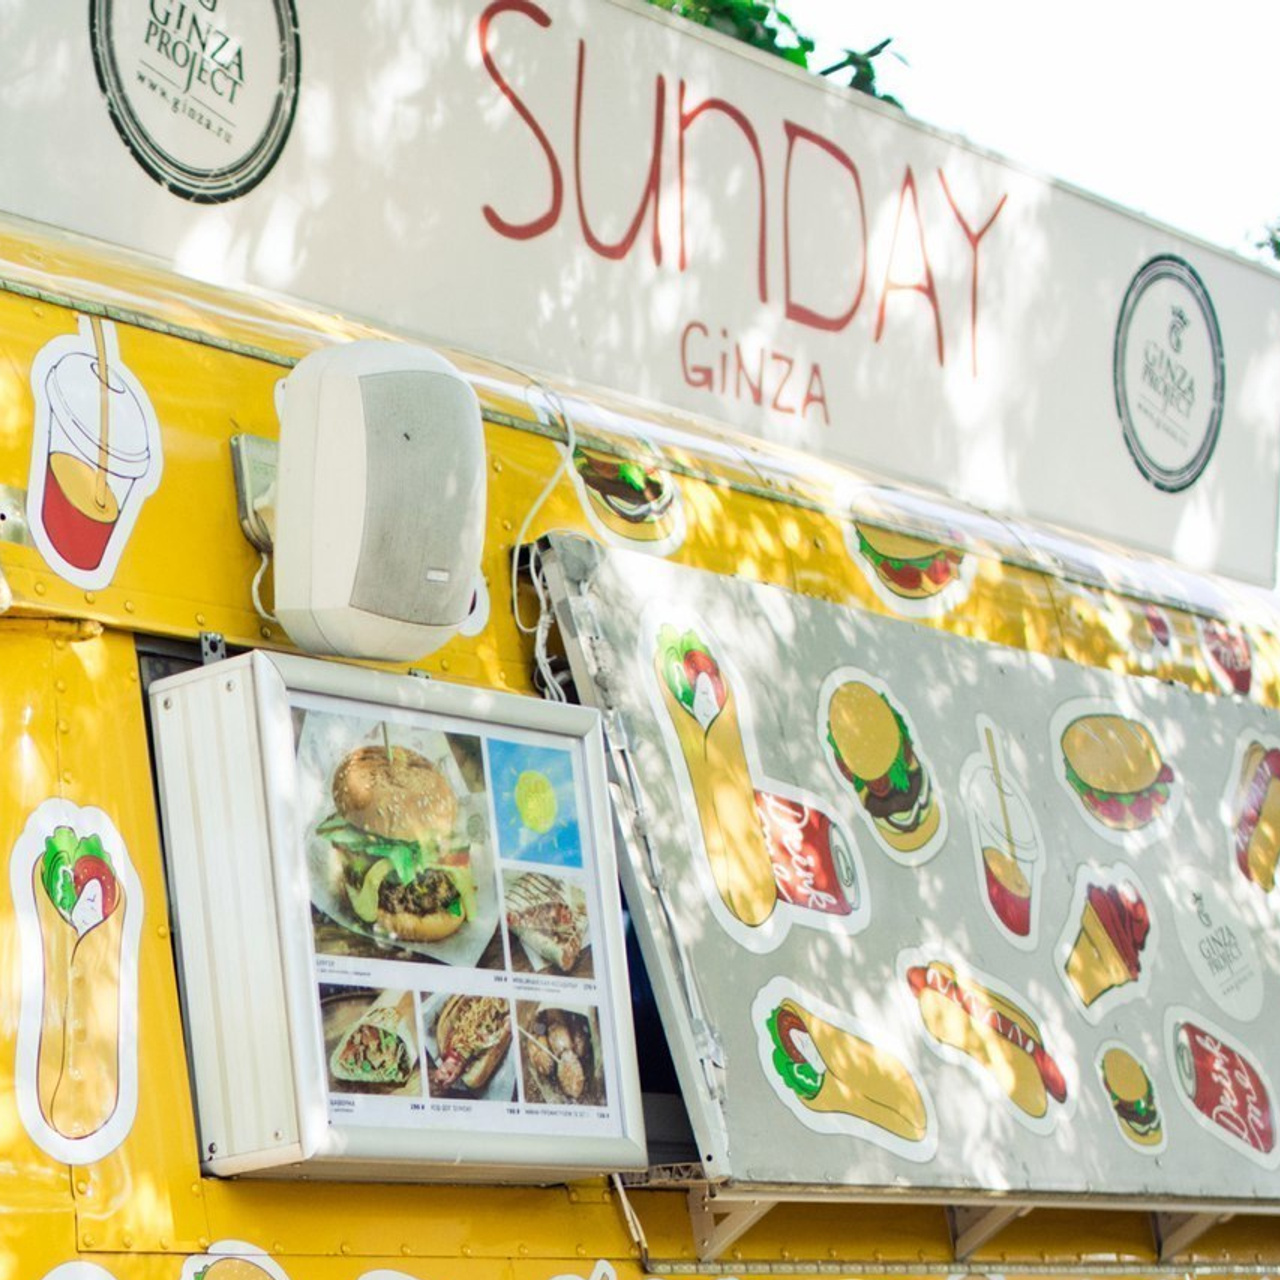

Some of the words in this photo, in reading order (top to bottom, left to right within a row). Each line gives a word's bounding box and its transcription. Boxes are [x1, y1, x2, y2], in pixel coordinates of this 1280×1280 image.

[144, 20, 245, 104] PROJECT
[150, 0, 244, 83] GINZA
[136, 70, 233, 145] www.ginza.ru
